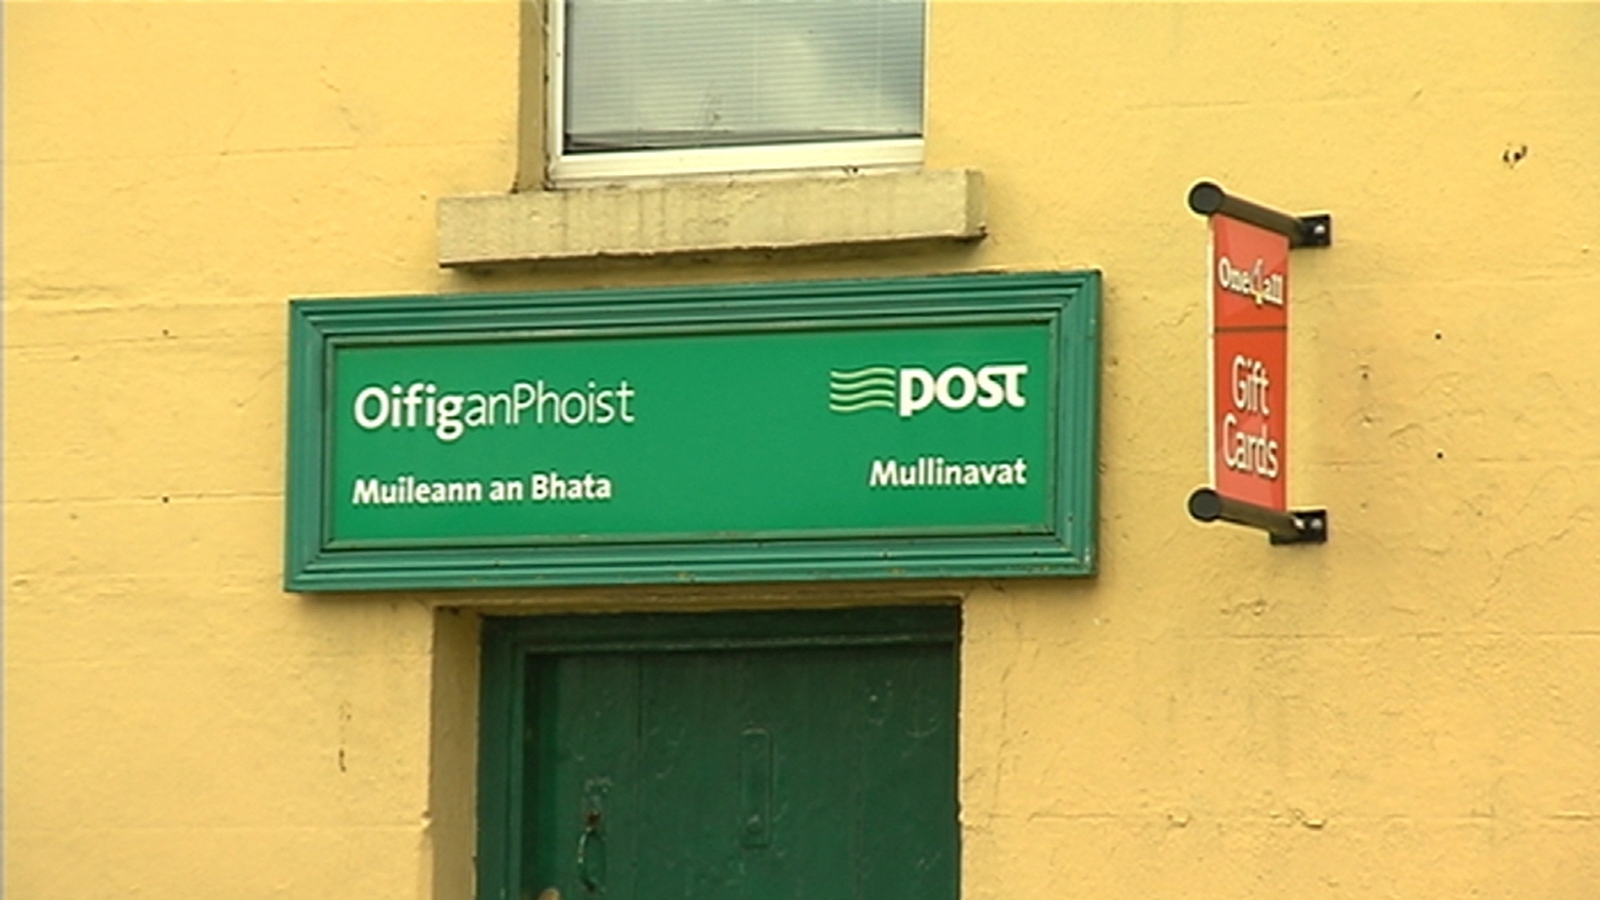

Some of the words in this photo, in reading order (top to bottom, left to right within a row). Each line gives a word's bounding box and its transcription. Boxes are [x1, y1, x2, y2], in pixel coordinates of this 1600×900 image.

[1232, 355, 1269, 415] Gift
[1223, 412, 1279, 478] Cards
[352, 476, 482, 504] Muileann
[489, 479, 523, 501] an
[531, 472, 611, 500] Bhata
[869, 457, 1027, 487] Mullinavat
